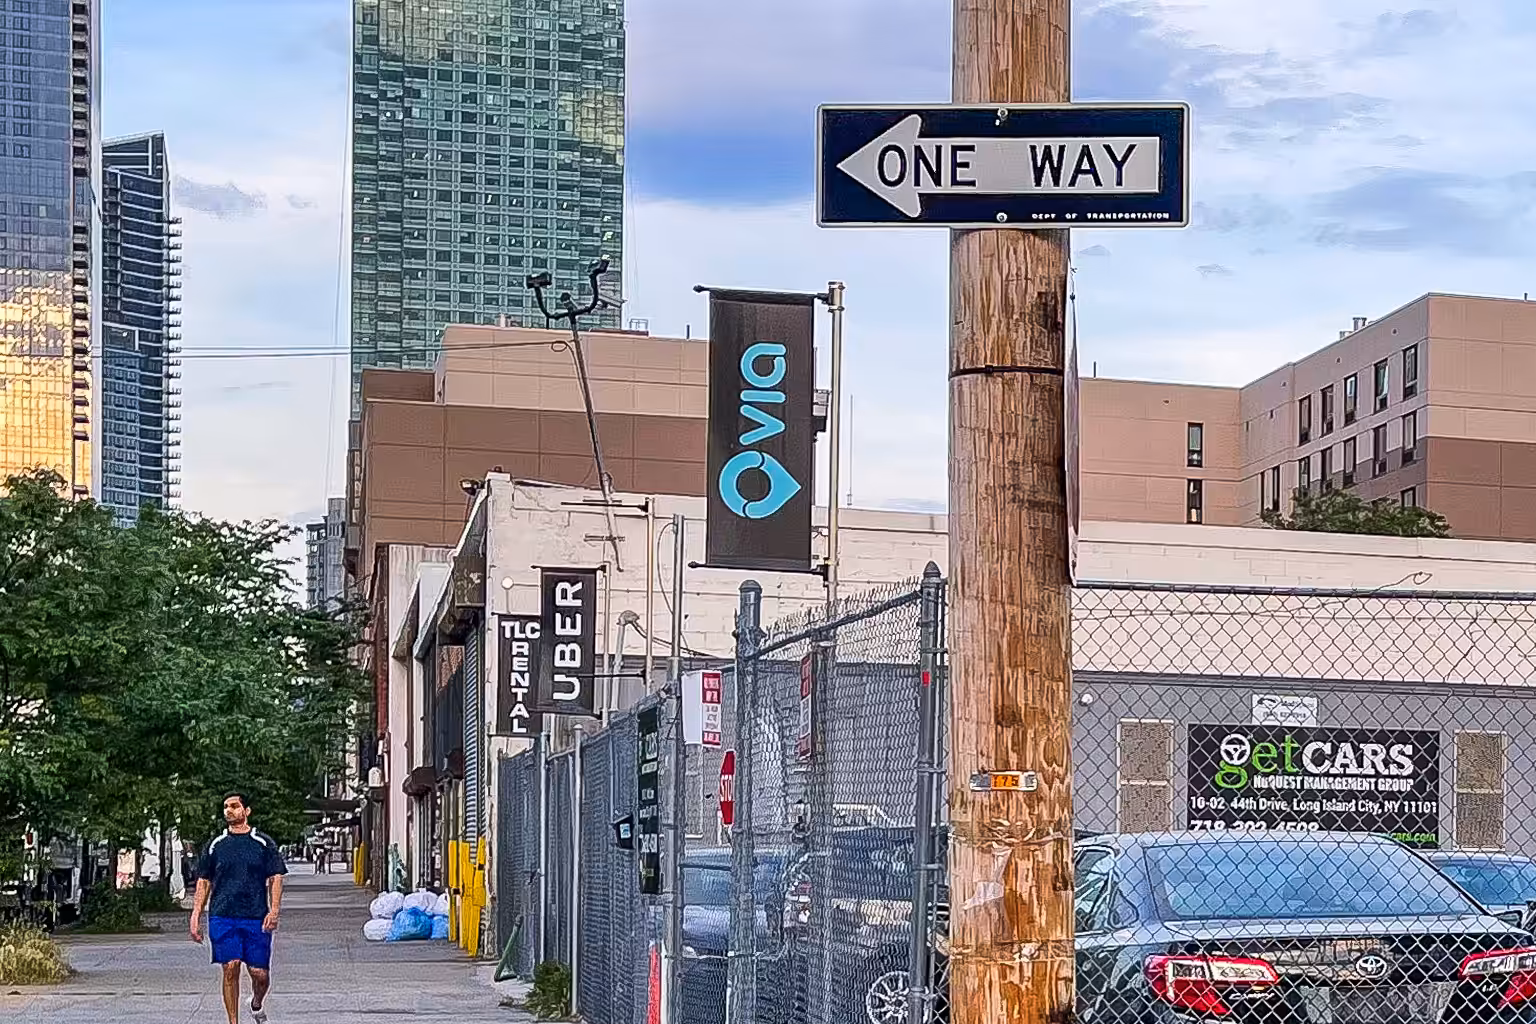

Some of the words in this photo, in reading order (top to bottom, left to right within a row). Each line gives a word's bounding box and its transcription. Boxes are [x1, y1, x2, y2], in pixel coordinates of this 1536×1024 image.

[877, 144, 978, 188] ONE
[1028, 144, 1138, 188] WAY
[1031, 212, 1057, 220] DEPT
[1086, 212, 1170, 220] TRANSPORTATION
[739, 342, 787, 446] via
[500, 621, 541, 639] TLC
[552, 581, 583, 701] UBER
[510, 641, 531, 734] RENTAL
[1377, 778, 1414, 792] GROUP
[1230, 797, 1257, 811] 44th
[1292, 798, 1321, 814] Long
[1322, 799, 1356, 812] Island
[1384, 801, 1401, 813] NY
